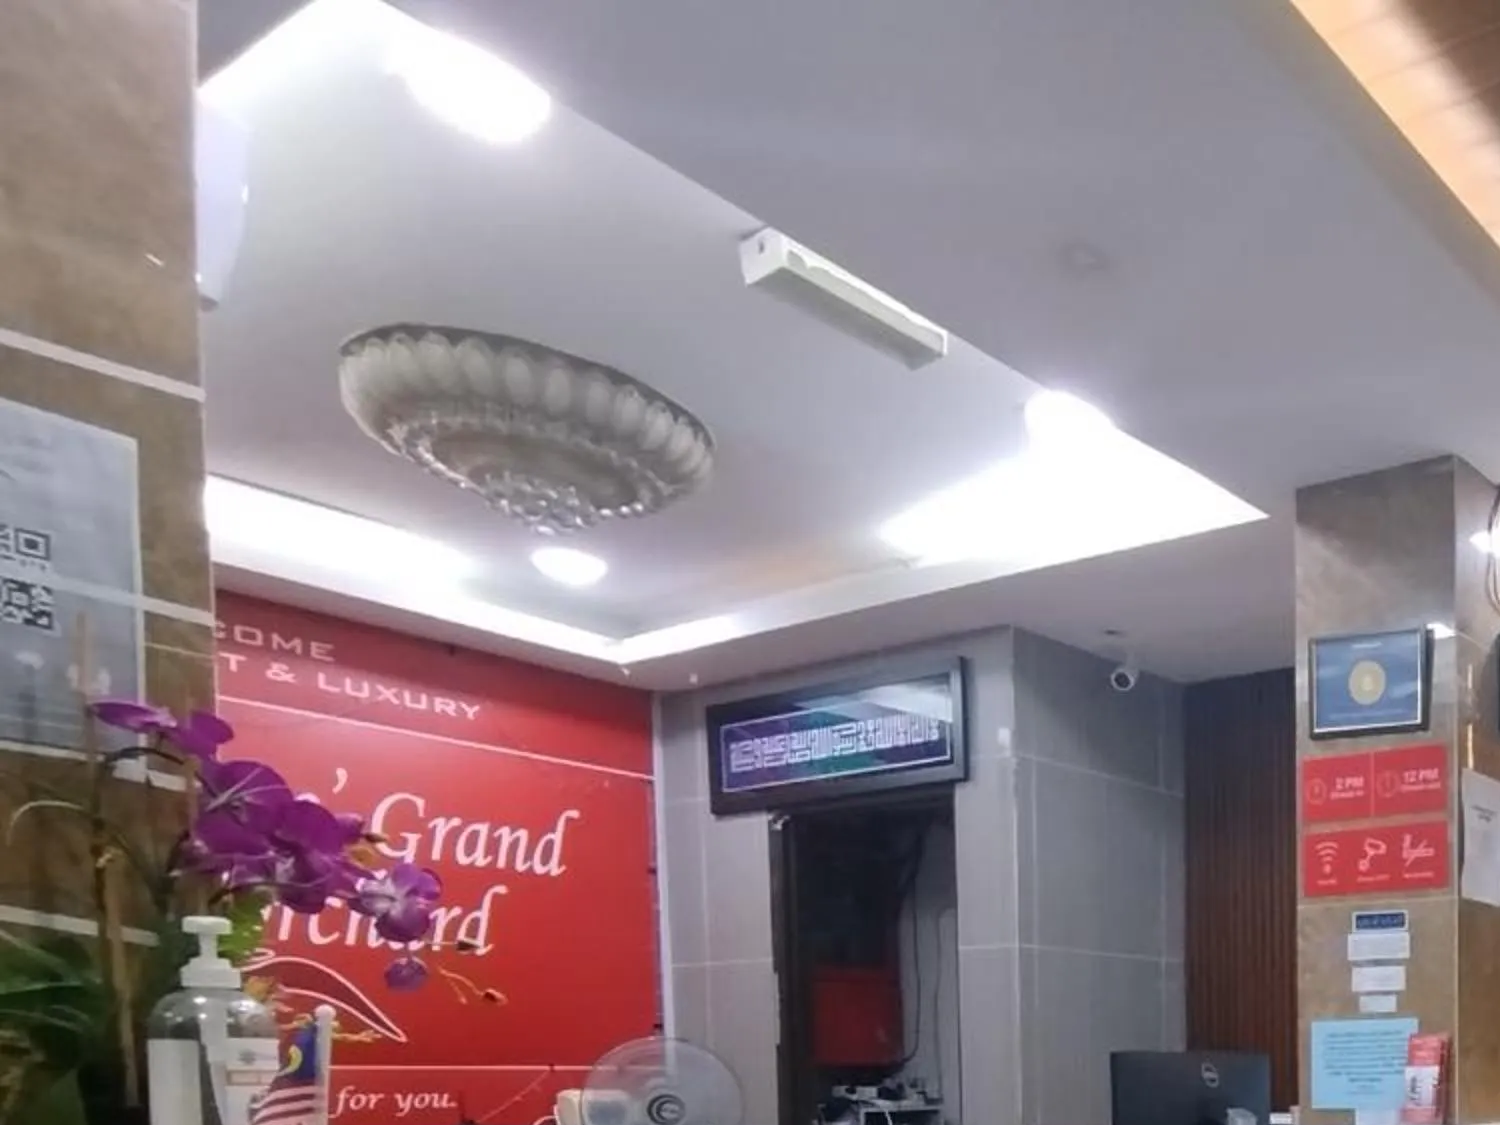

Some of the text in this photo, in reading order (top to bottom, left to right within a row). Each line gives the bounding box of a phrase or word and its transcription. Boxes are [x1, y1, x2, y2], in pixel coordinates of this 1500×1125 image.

[266, 662, 297, 684] &
[317, 671, 481, 721] LUXURY
[370, 791, 581, 877] Grand
[328, 1085, 459, 1119] for you.
